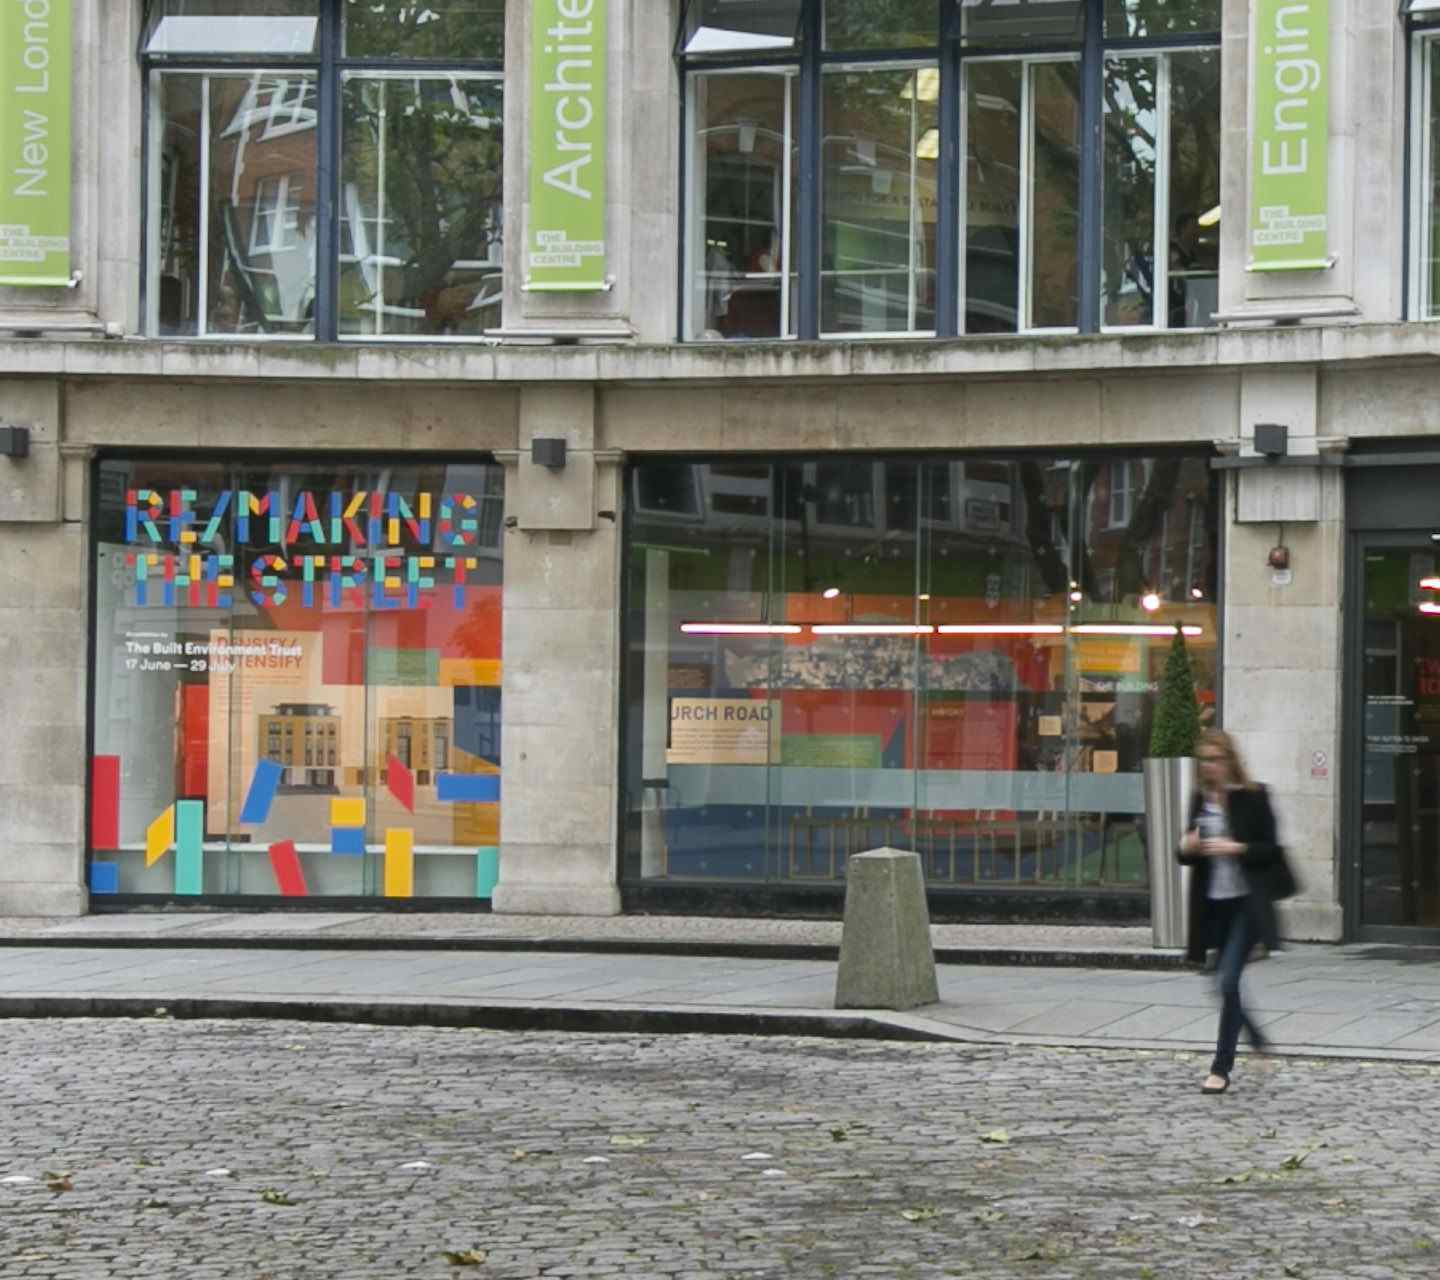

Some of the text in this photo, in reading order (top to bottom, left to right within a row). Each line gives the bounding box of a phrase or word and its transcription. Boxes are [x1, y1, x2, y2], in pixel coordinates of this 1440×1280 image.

[14, 110, 48, 198] New
[125, 489, 478, 546] RE/MAKING
[124, 553, 478, 609] THE STREET
[125, 641, 303, 656] The Built Environment Trust
[125, 659, 139, 670] 17
[139, 659, 172, 671] June
[190, 659, 208, 672] 29
[723, 706, 774, 721] ROAD
